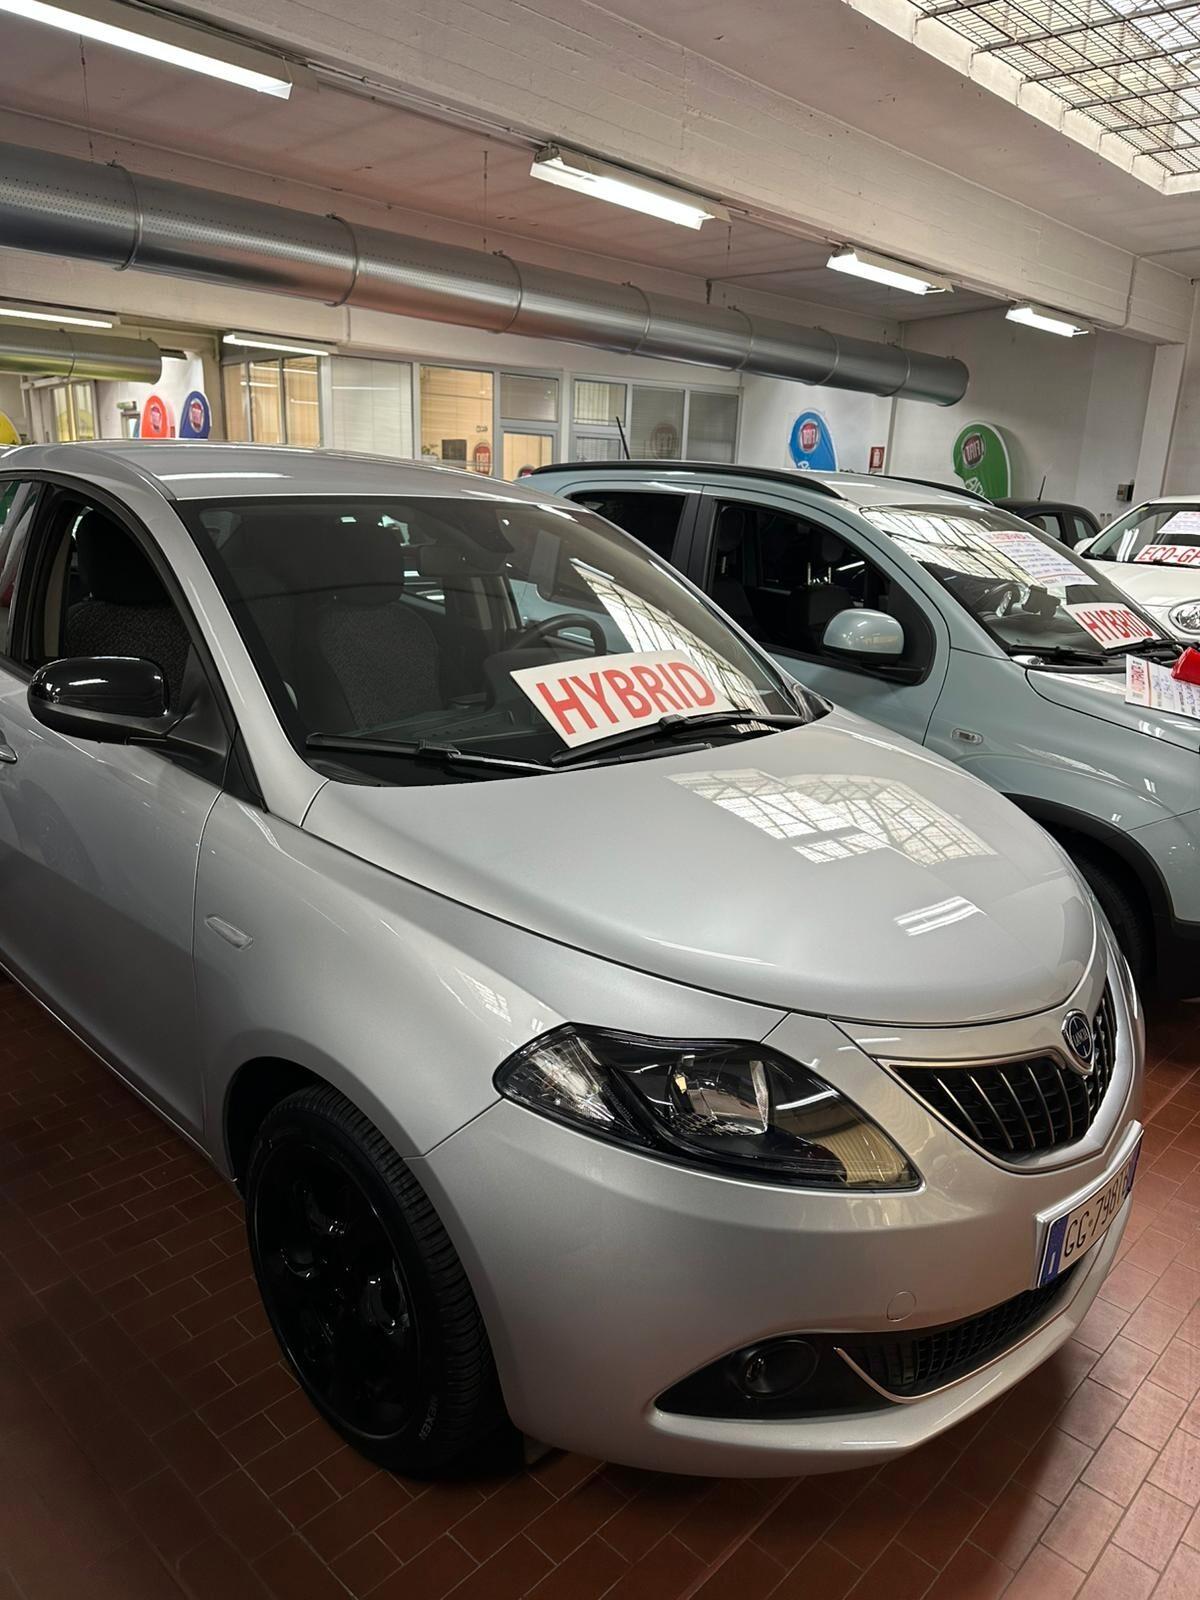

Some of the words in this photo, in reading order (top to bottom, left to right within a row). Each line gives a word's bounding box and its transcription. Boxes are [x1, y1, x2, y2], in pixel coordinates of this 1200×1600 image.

[1075, 609, 1153, 642] HYBRID
[535, 661, 716, 735] HYBRID
[1064, 1210, 1089, 1257] GG
